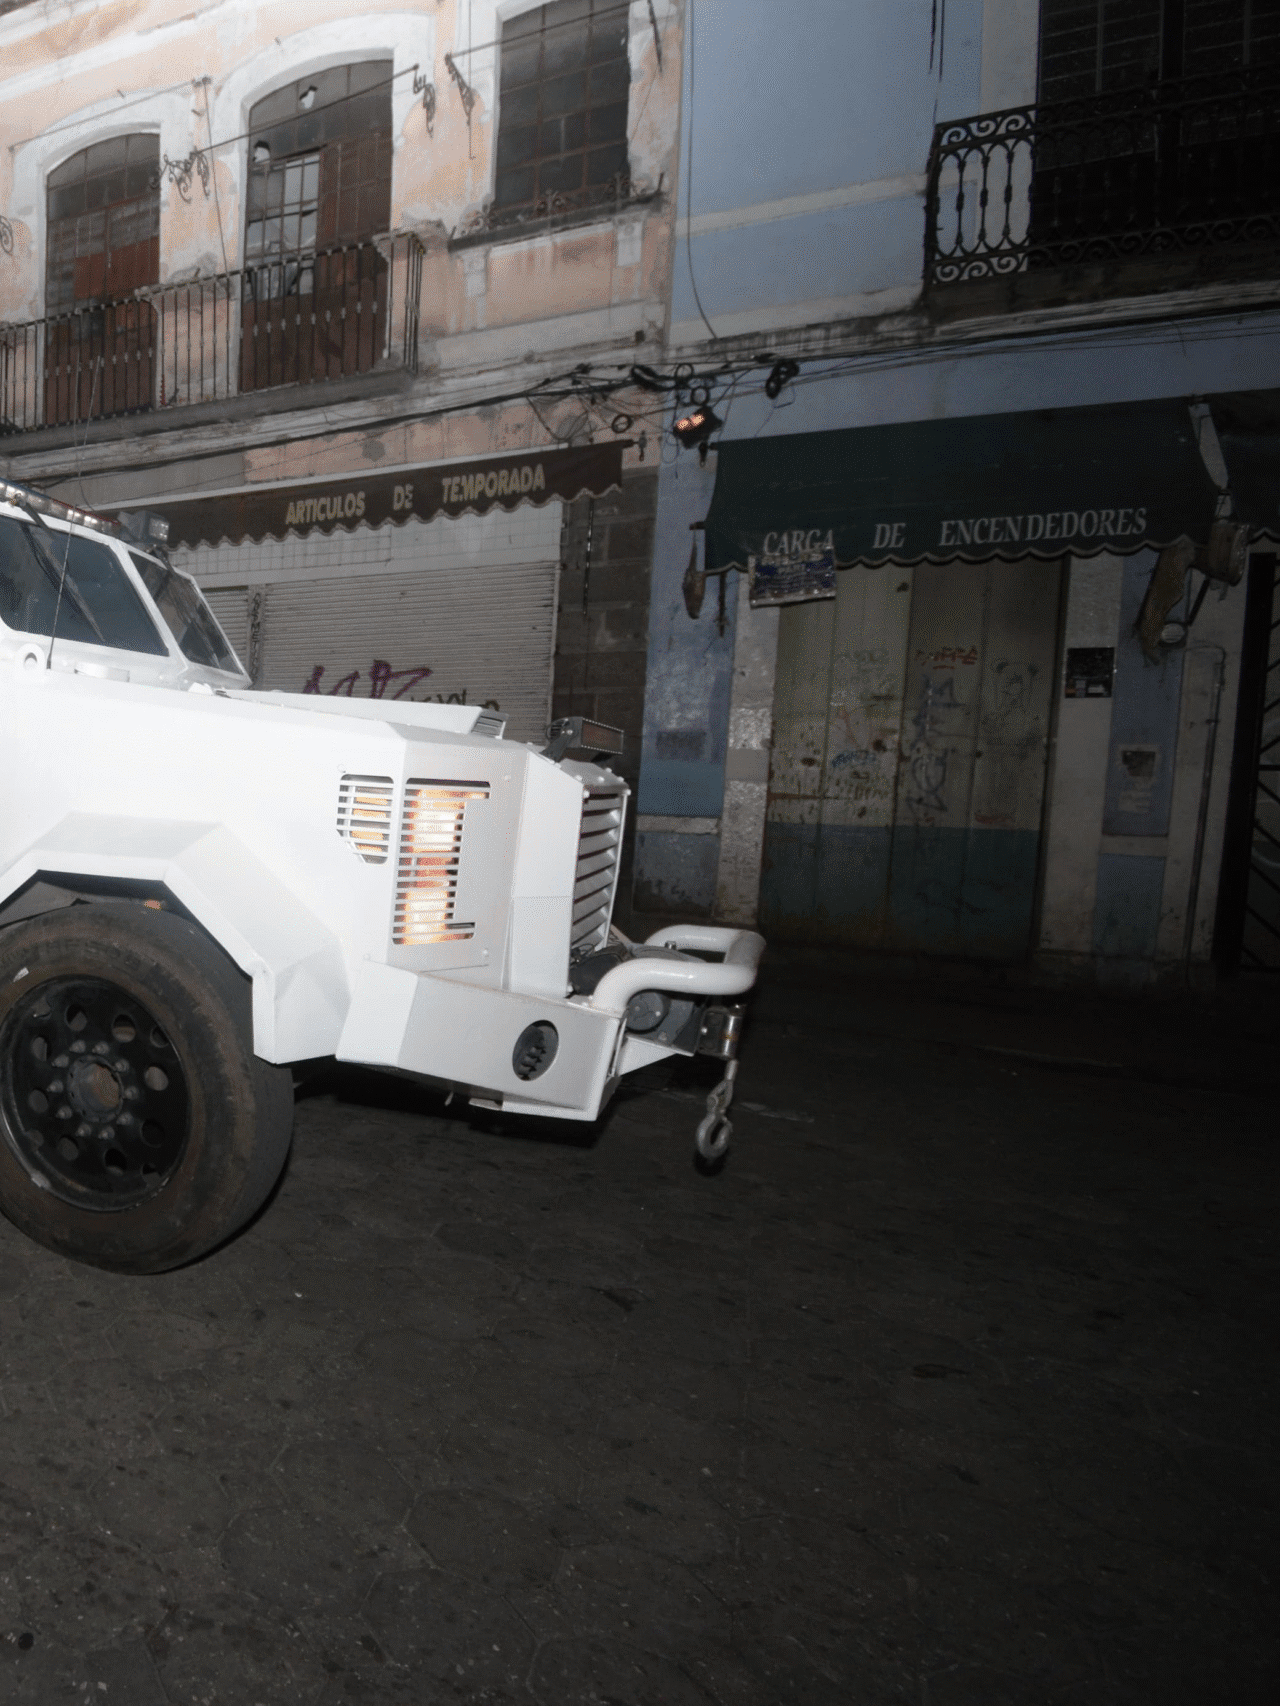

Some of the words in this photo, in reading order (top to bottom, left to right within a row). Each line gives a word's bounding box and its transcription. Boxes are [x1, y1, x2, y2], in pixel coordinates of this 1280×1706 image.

[285, 491, 366, 525] ARTICULOS
[393, 484, 414, 511] DE
[442, 463, 546, 503] TEMPORADA
[763, 530, 835, 555] CARGA
[872, 522, 907, 550] DE
[939, 507, 1148, 547] ENCENDEDORES
